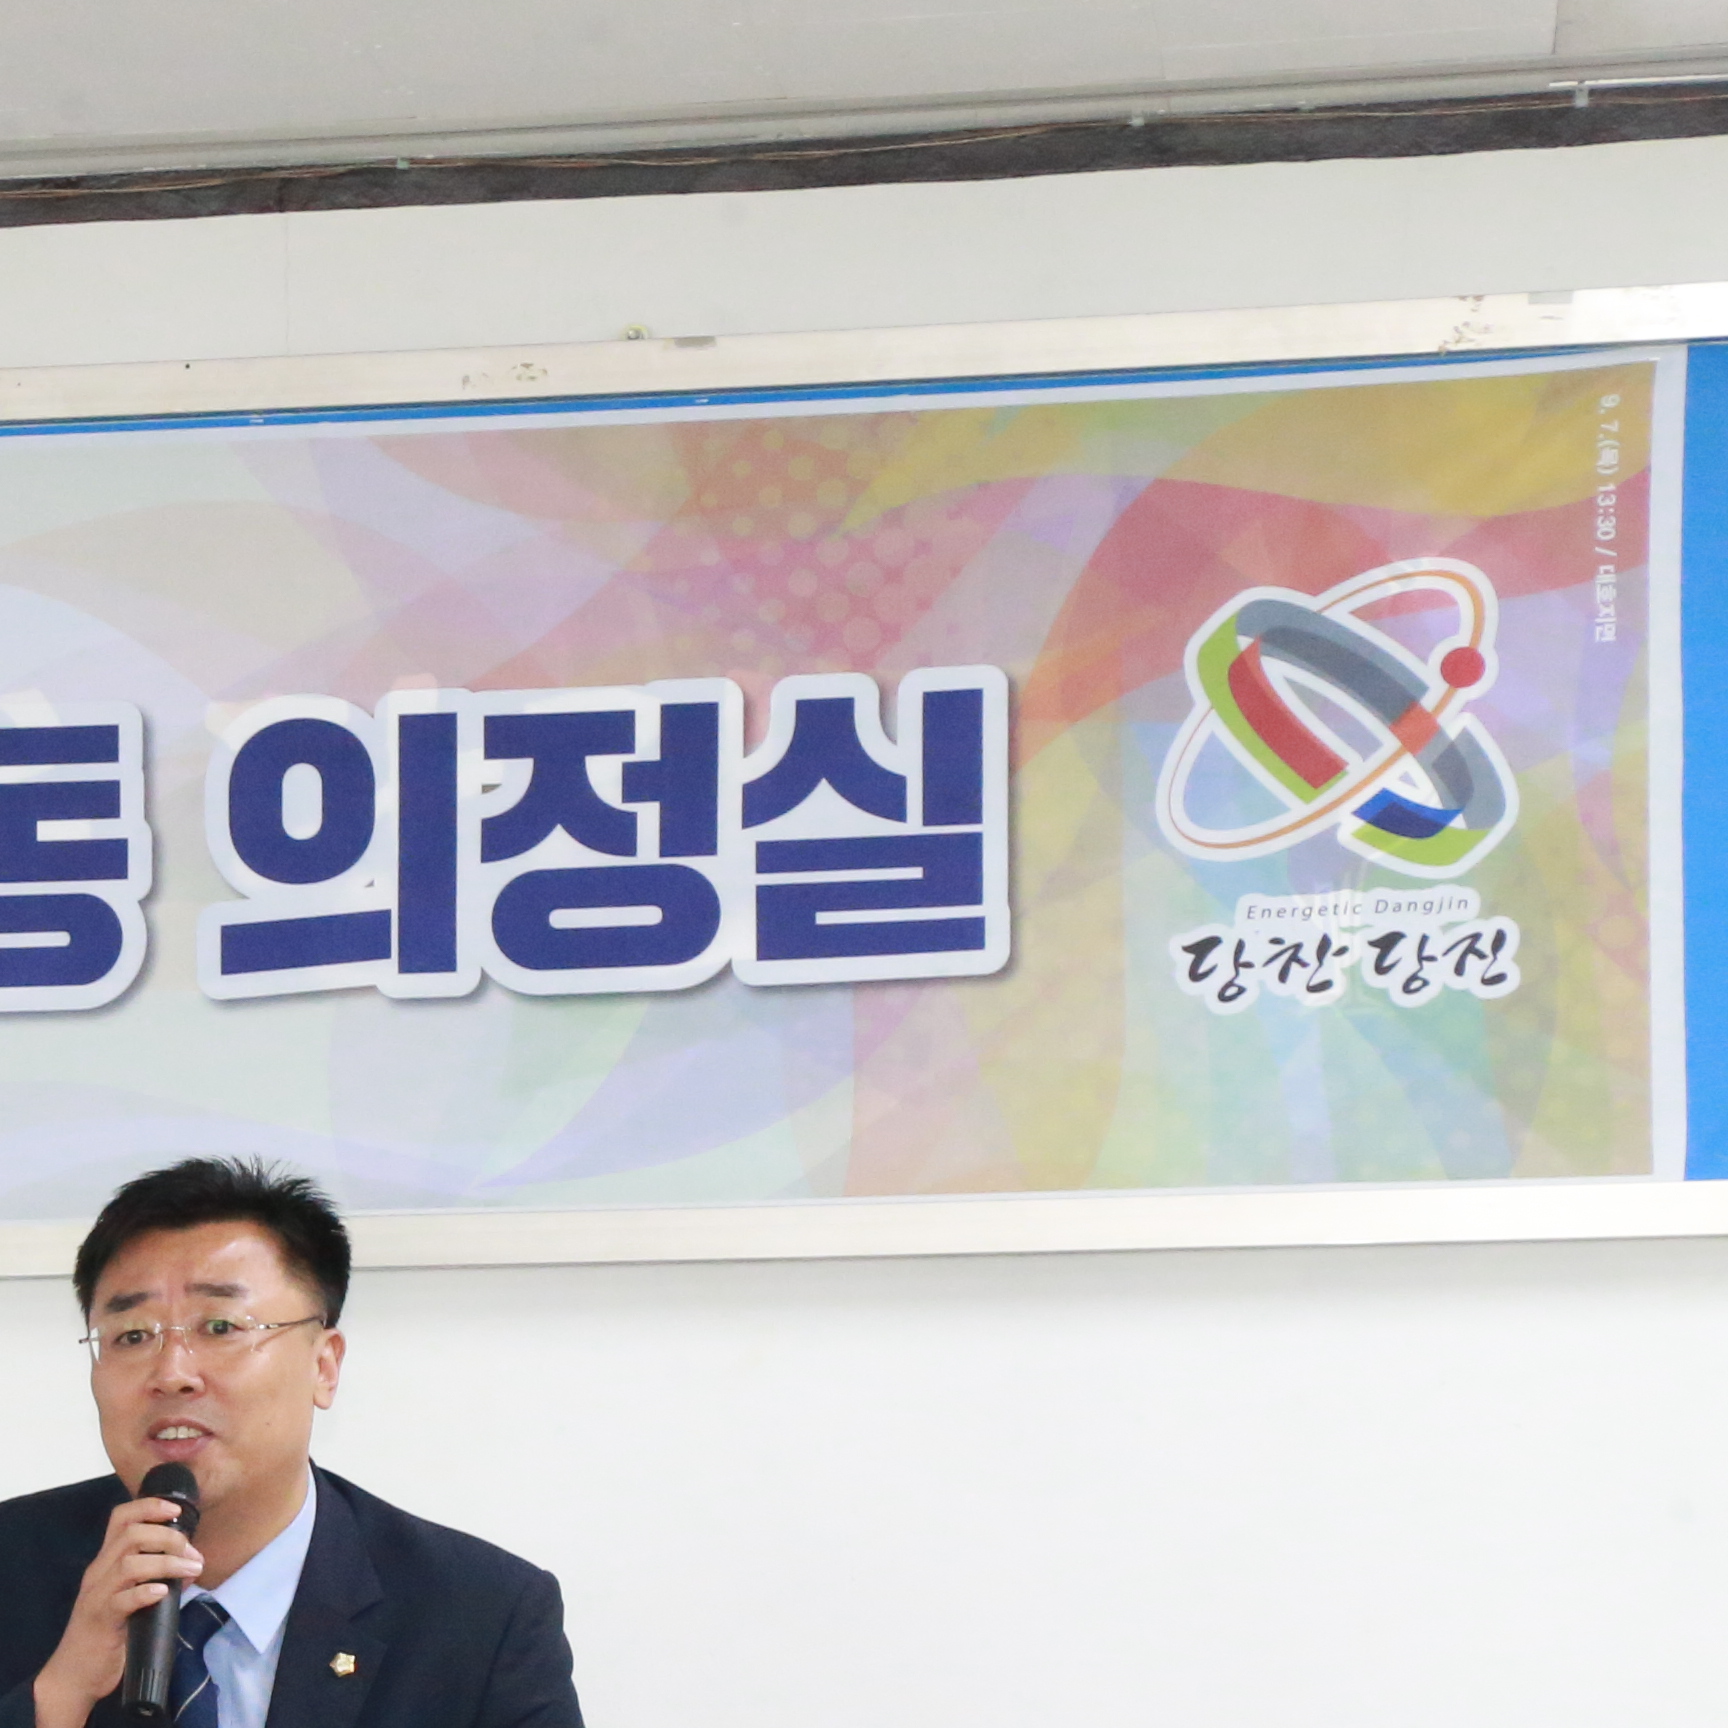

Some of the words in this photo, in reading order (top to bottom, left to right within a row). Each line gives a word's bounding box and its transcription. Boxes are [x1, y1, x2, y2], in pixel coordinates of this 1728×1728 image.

[1596, 482, 1617, 541] 13:30
[1595, 564, 1617, 642] 대호지면
[218, 688, 988, 976] 의정실
[1246, 902, 1363, 922] Energetic
[1374, 896, 1470, 917] Dangjin
[1181, 932, 1350, 1003] 당찬
[1367, 928, 1508, 995] 당진
